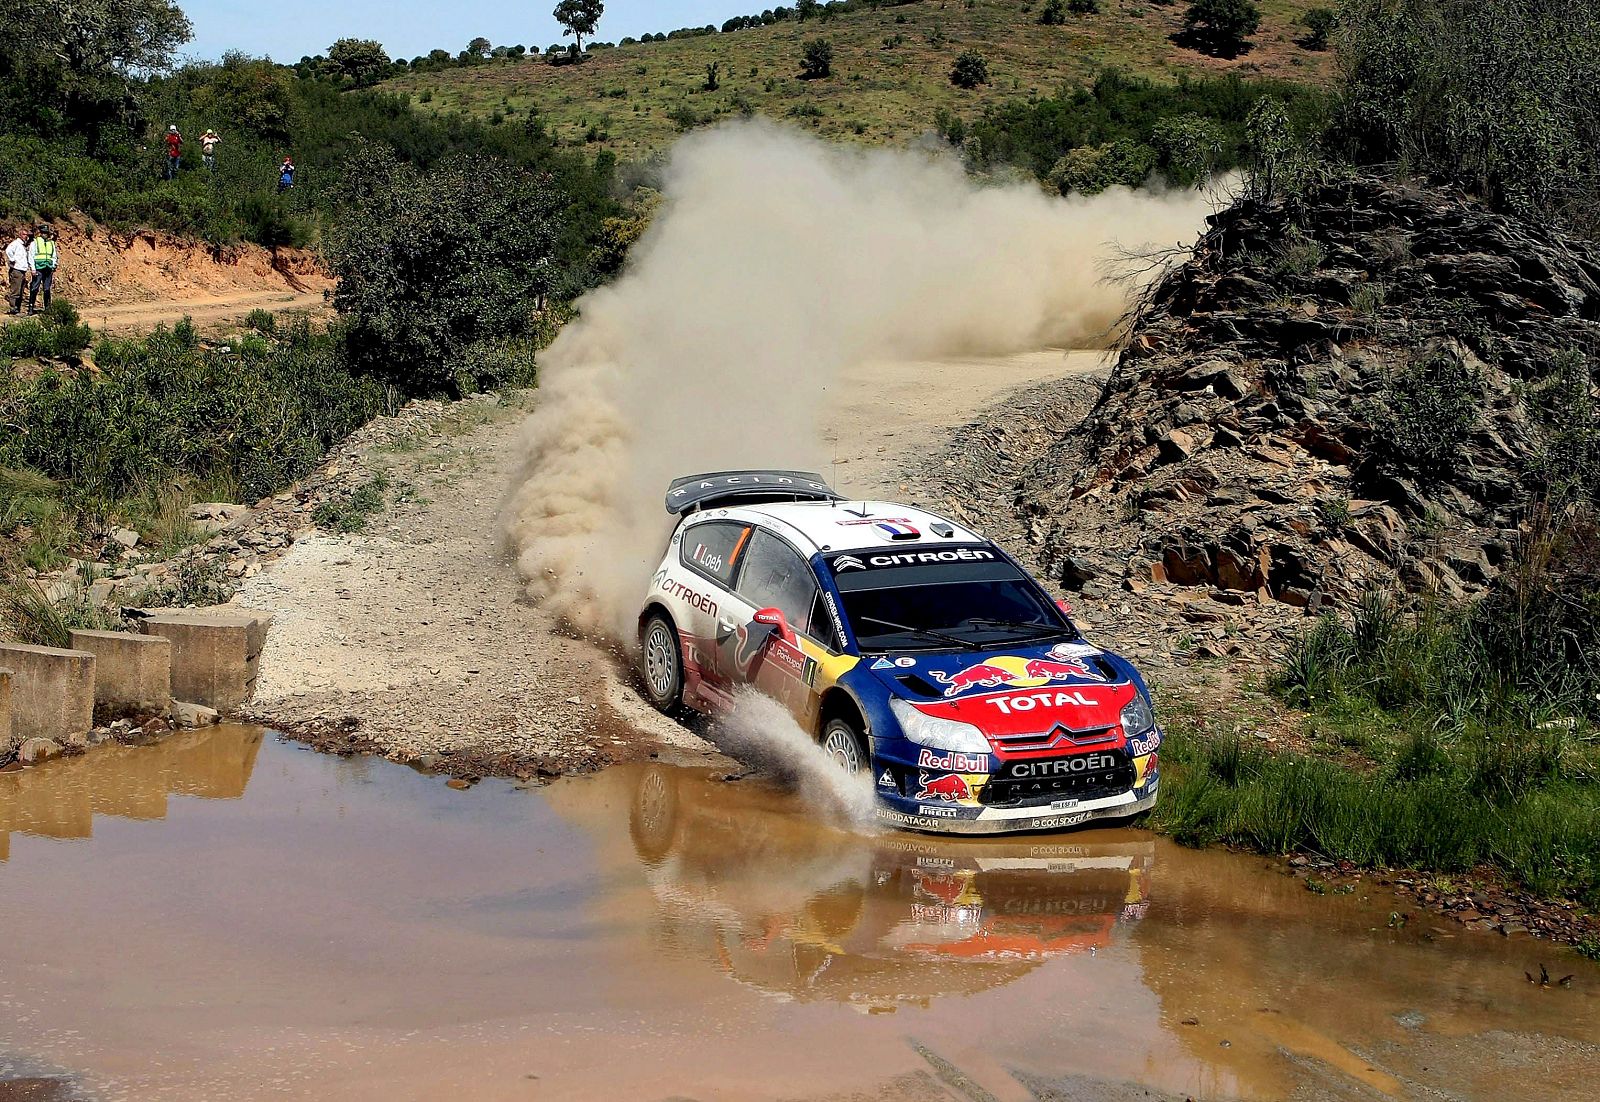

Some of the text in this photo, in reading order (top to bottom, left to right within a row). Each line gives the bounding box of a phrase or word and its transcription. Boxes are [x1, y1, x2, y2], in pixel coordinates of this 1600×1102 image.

[700, 546, 721, 572] Loeb
[985, 691, 1099, 715] TOTAL
[919, 750, 988, 772] Red Bull
[876, 809, 940, 827] EURODATACAR
[919, 806, 957, 818] PIRELLI
[1031, 819, 1040, 827] le
